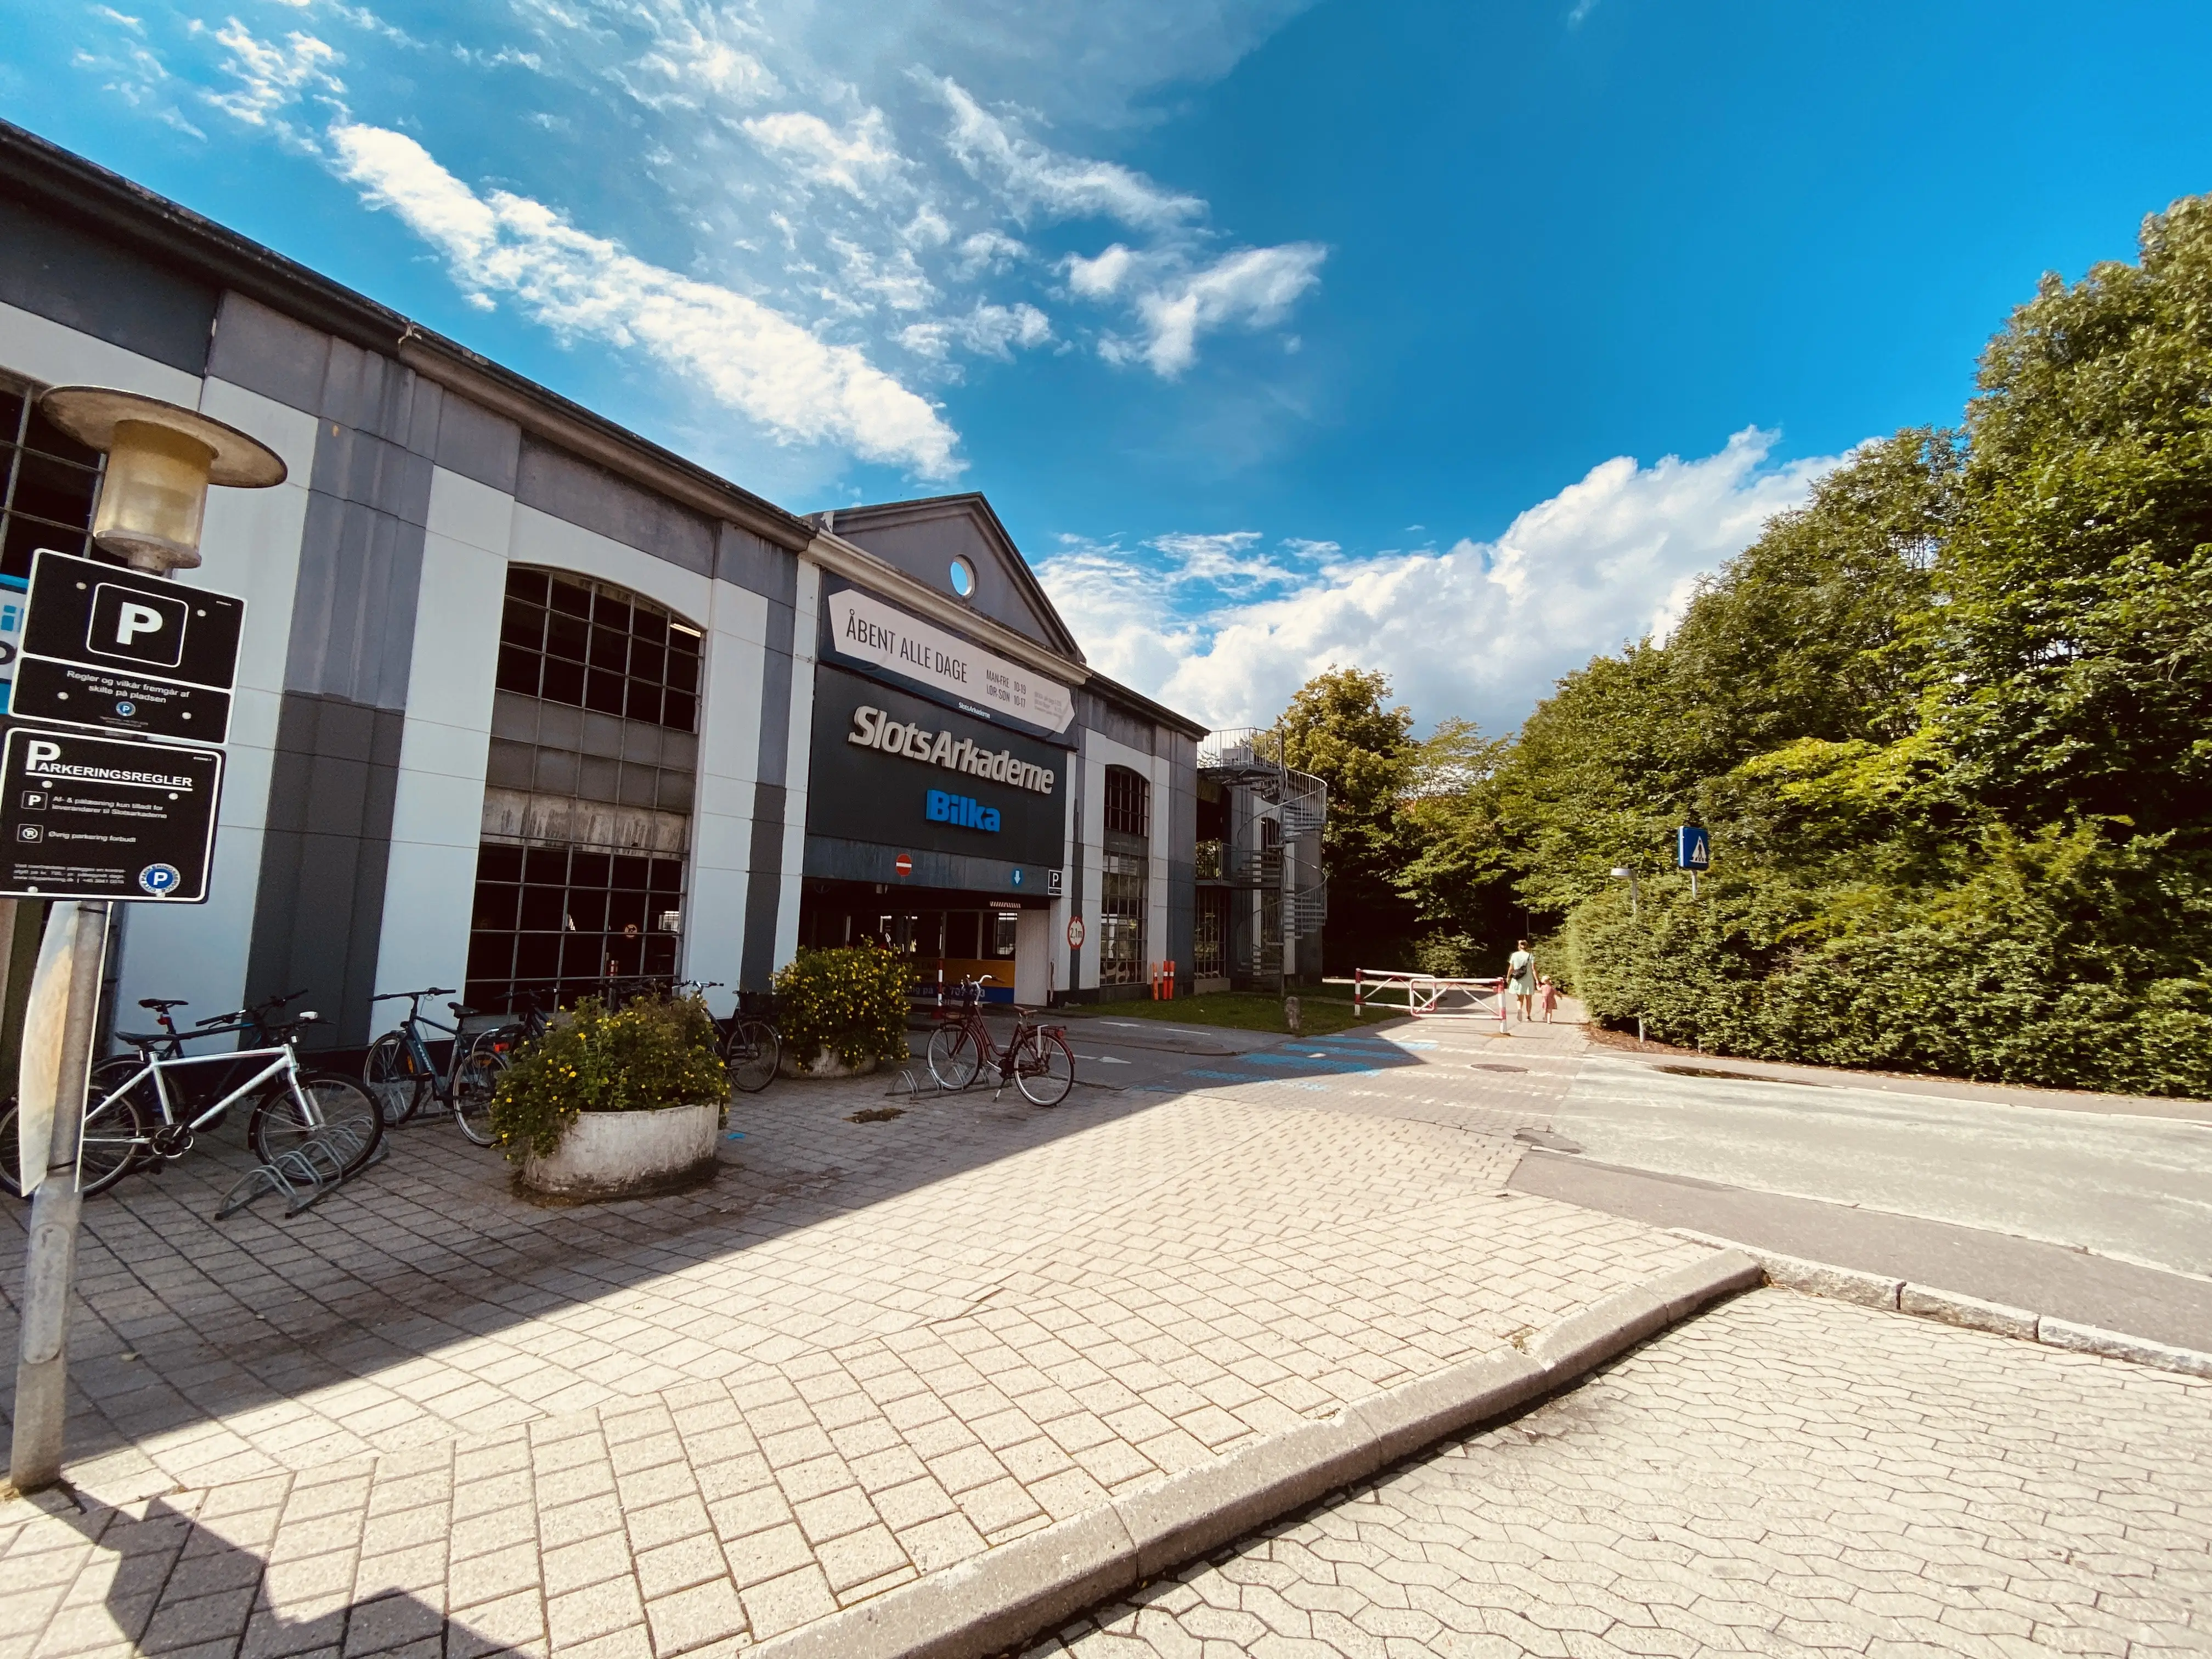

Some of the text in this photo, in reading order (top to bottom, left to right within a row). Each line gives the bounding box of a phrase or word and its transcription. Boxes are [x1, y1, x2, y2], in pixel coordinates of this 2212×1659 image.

[116, 602, 163, 645] P
[846, 608, 967, 683] ÅBENT ALLE DAGE
[67, 670, 99, 682] Regler
[116, 679, 142, 689] vilkår
[143, 684, 179, 696] fremgår
[88, 686, 113, 695] skilte
[130, 692, 167, 703] pladsen
[986, 669, 1026, 695] MAN-FRE 10-19
[986, 685, 1010, 702] LØR-SØN
[1014, 696, 1026, 708] 10-17
[848, 706, 1054, 794] SlotsArkaderne
[26, 740, 193, 787] PARKERINGSREGLER
[28, 794, 41, 805] P
[926, 789, 1001, 832] Bilka
[153, 872, 168, 885] P
[1052, 872, 1059, 887] P
[1070, 927, 1082, 939] 2,1m
